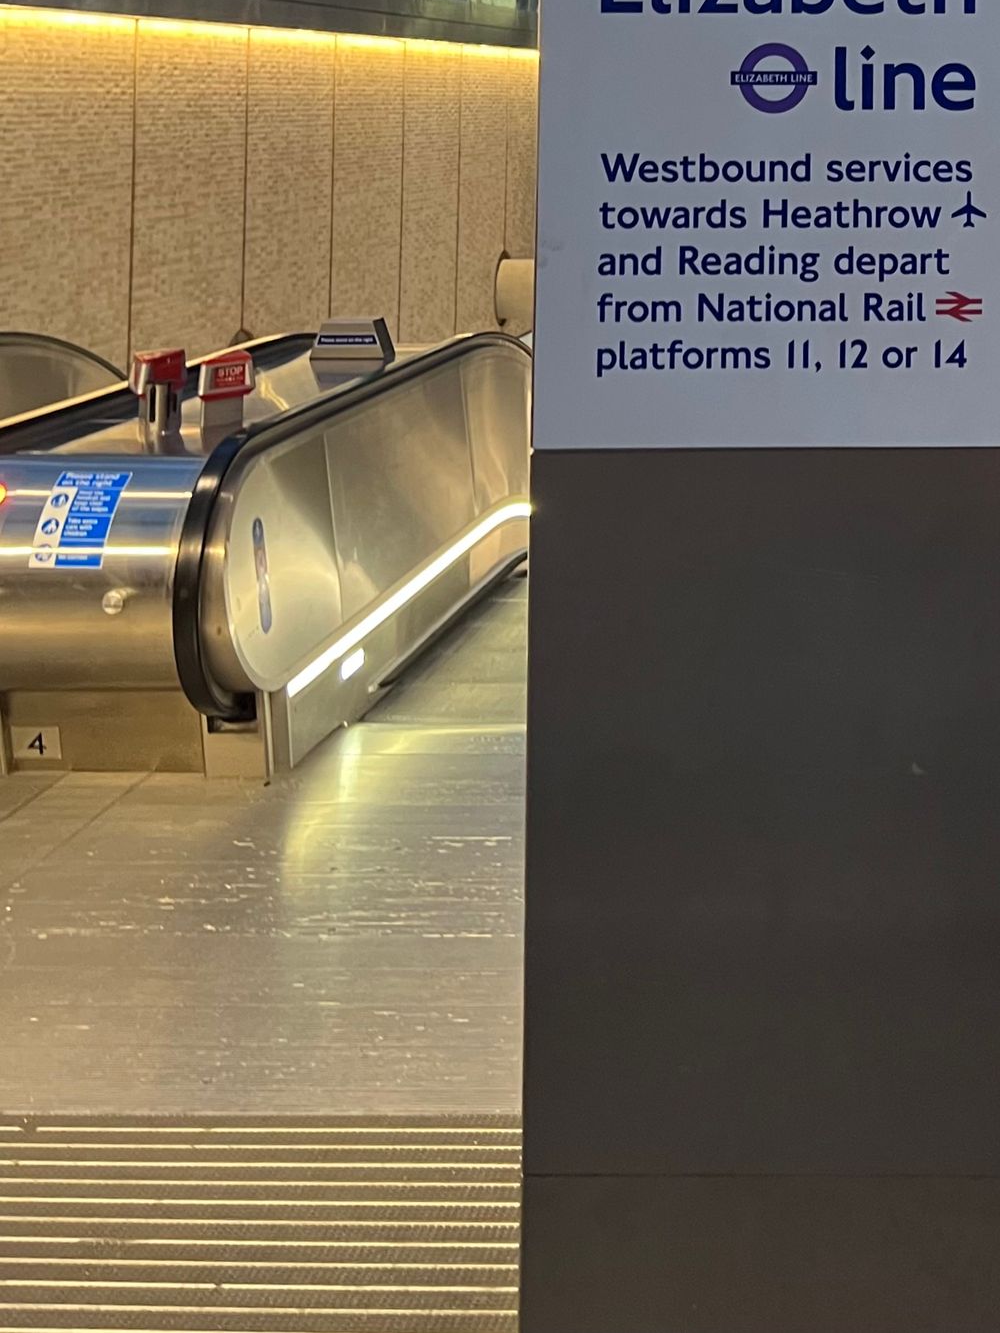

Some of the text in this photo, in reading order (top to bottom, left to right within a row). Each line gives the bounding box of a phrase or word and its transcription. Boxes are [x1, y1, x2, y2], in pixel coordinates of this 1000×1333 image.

[735, 73, 813, 83] ELIZABETH LINE
[834, 44, 977, 112] line
[600, 152, 974, 183] Westbound services
[599, 198, 943, 230] towards Heathrow
[597, 245, 951, 283] and Reading depart
[597, 292, 927, 323] from National Rail
[217, 365, 244, 378] STOP
[596, 339, 968, 378] platforms 11, 12 or 14
[27, 732, 47, 755] 4
